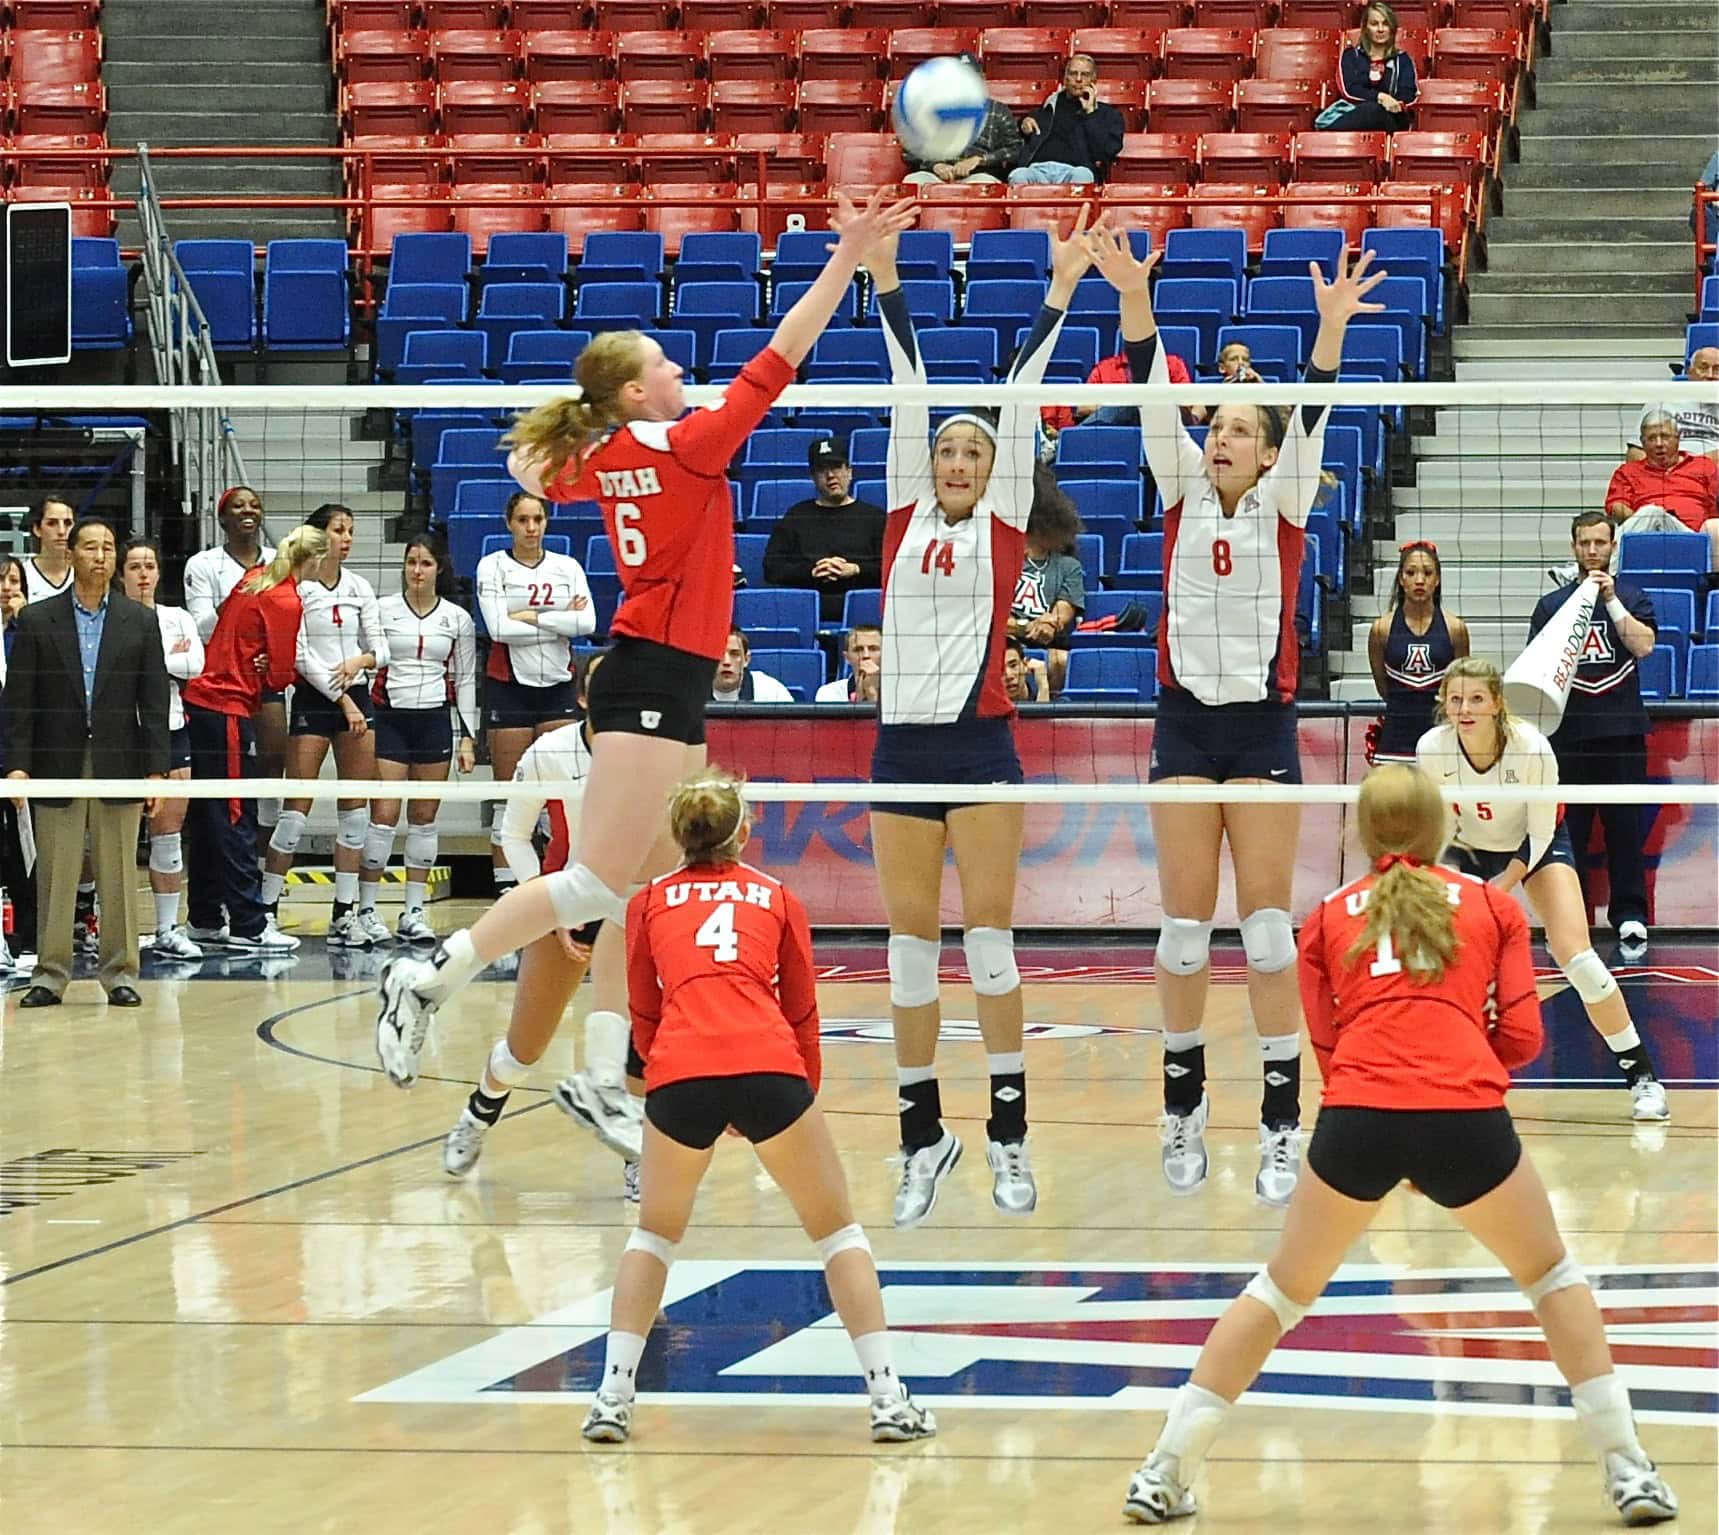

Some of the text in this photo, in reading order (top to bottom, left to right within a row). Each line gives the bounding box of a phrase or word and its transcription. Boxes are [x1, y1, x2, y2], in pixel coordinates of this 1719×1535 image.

[594, 466, 663, 498] UTAH
[614, 502, 647, 566] 6
[921, 538, 956, 577] 14
[1211, 539, 1233, 577] 8
[527, 583, 555, 607] 22
[332, 604, 343, 628] 4
[1401, 643, 1435, 675] A
[1577, 621, 1616, 664] A
[665, 881, 773, 909] UTAH
[695, 902, 739, 963] 4
